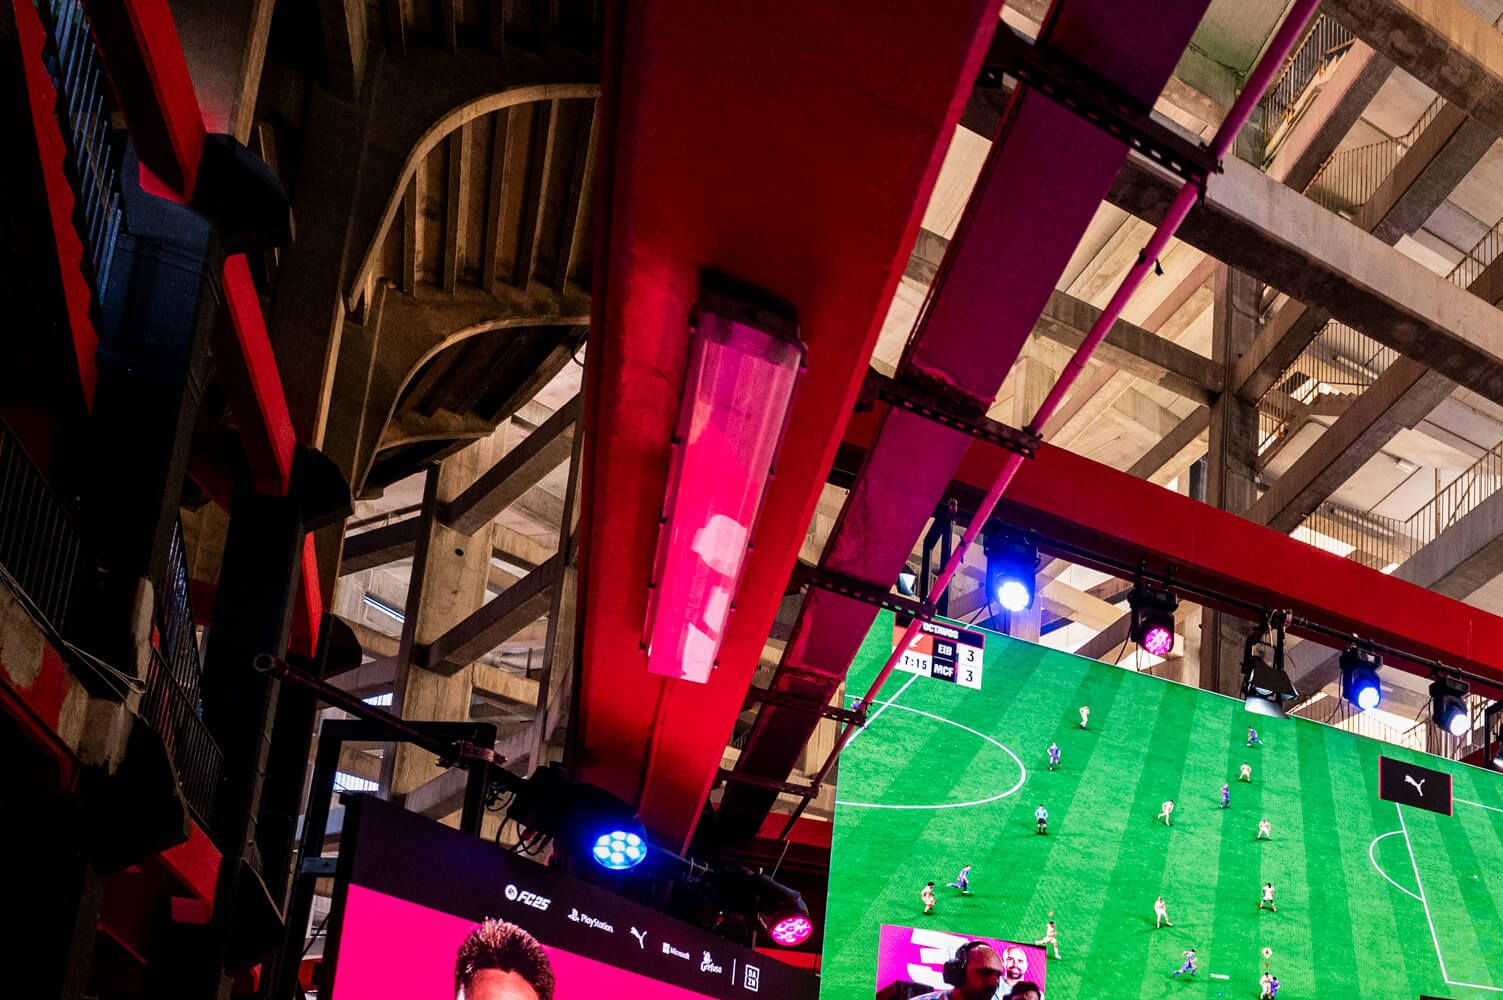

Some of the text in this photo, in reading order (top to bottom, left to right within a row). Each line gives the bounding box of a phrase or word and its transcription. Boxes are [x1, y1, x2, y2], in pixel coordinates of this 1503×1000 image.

[898, 655, 927, 670] 7:15
[967, 649, 975, 662] 3
[933, 663, 973, 682] MCF 3
[580, 913, 614, 934] PlayStation
